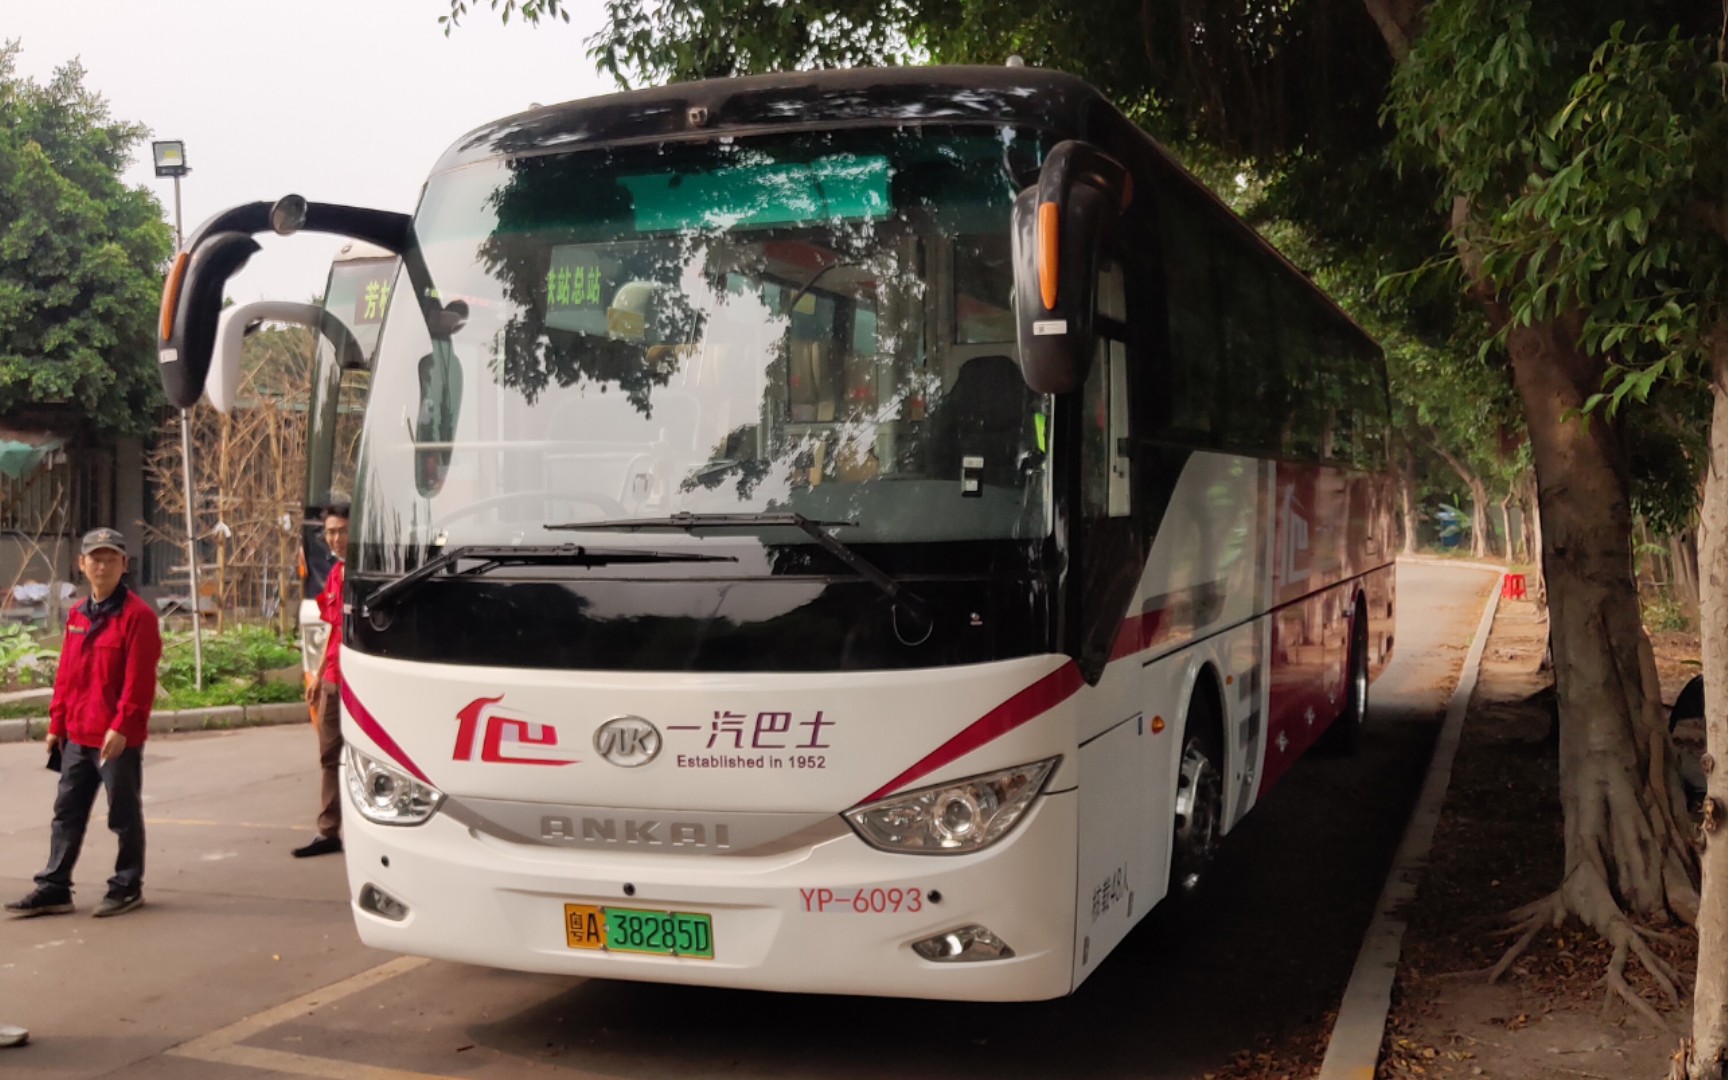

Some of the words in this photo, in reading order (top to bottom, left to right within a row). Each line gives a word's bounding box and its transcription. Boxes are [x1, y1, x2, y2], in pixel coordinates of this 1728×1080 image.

[666, 710, 836, 749] 一汽巴士
[677, 754, 764, 769] Established
[769, 756, 783, 769] in
[788, 755, 826, 769] 1952
[540, 815, 730, 848] ANKAI
[799, 887, 922, 913] YP-6093
